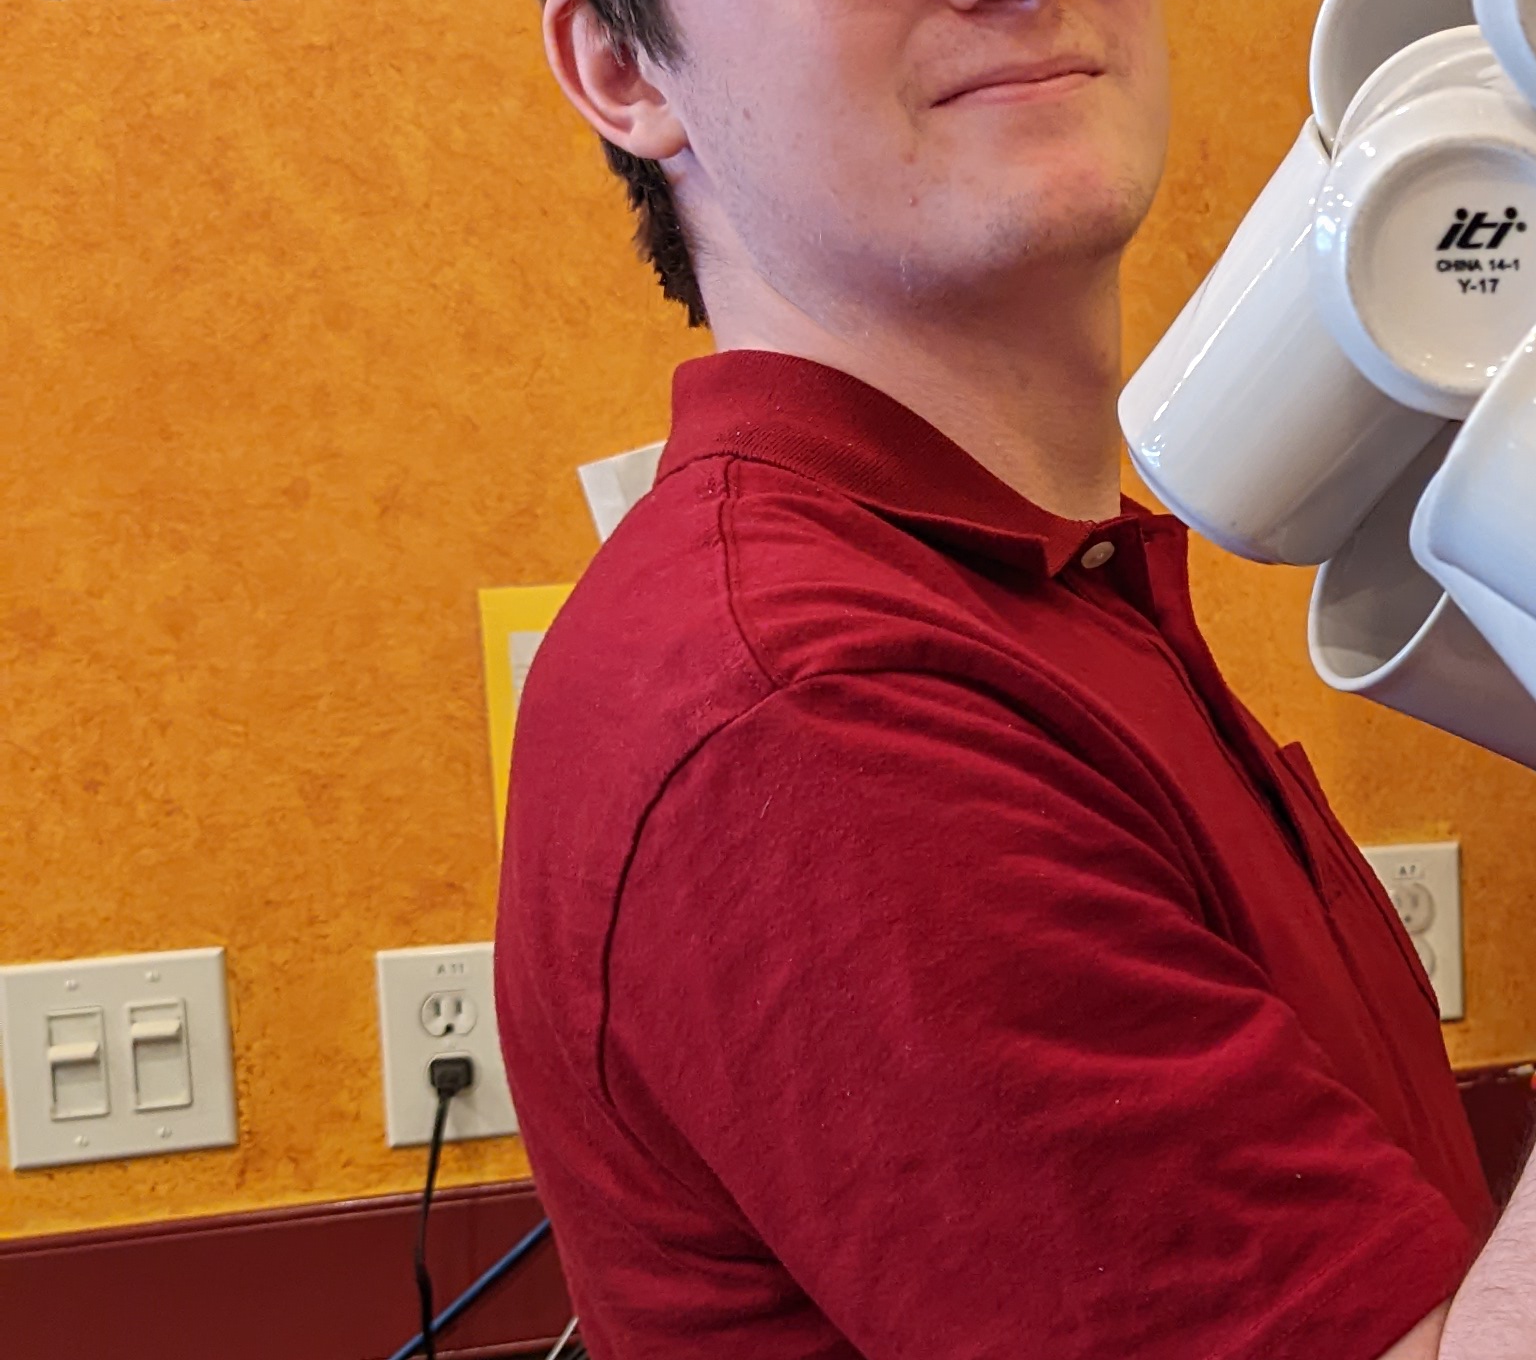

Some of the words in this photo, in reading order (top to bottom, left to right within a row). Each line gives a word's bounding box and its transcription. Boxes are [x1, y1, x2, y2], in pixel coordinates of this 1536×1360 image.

[1436, 258, 1483, 272] CHINA
[1488, 257, 1521, 272] 14-1
[1457, 277, 1500, 294] Y-17
